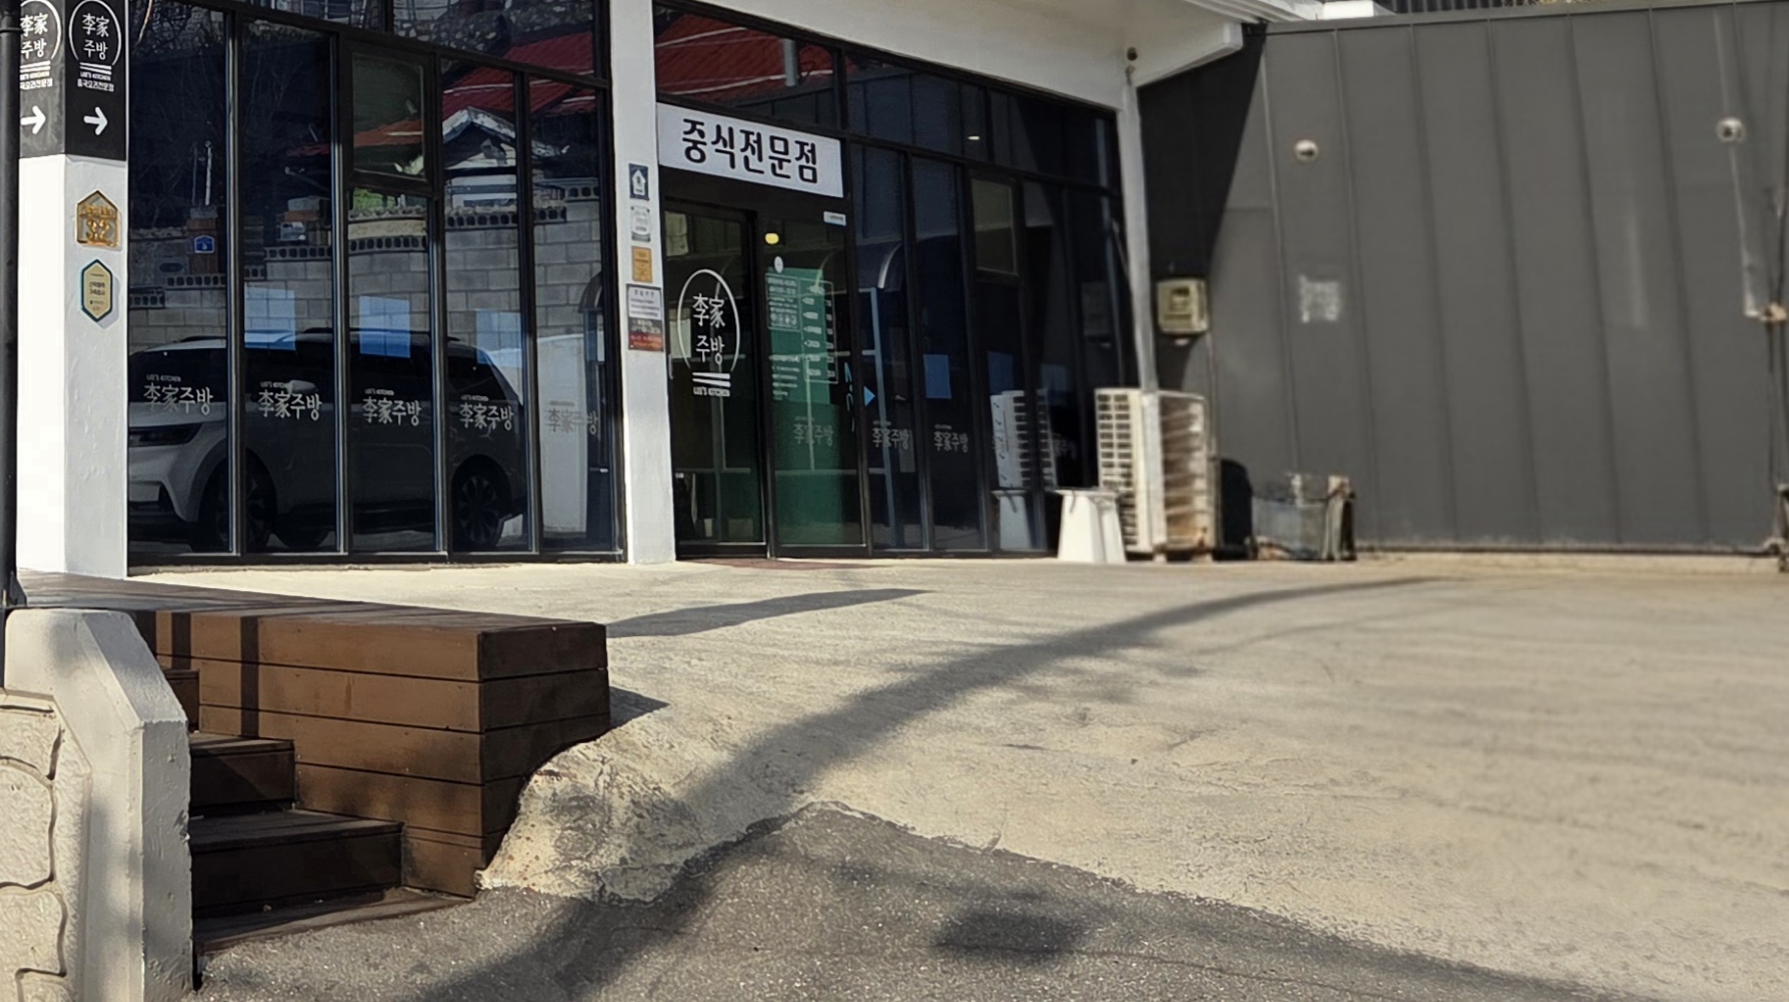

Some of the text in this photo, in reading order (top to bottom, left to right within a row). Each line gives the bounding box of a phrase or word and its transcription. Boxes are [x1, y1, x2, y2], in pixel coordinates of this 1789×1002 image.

[20, 13, 49, 37] 李家
[82, 13, 110, 37] 李家
[20, 38, 48, 59] 주방
[83, 39, 108, 60] 주방
[682, 119, 818, 184] 중식전문점
[692, 293, 726, 329] 李家
[695, 335, 725, 364] 주방
[143, 382, 214, 415] 李家주방
[258, 389, 323, 421] 李家주방
[363, 396, 423, 426] 李家주방
[459, 402, 515, 431] 李家주방
